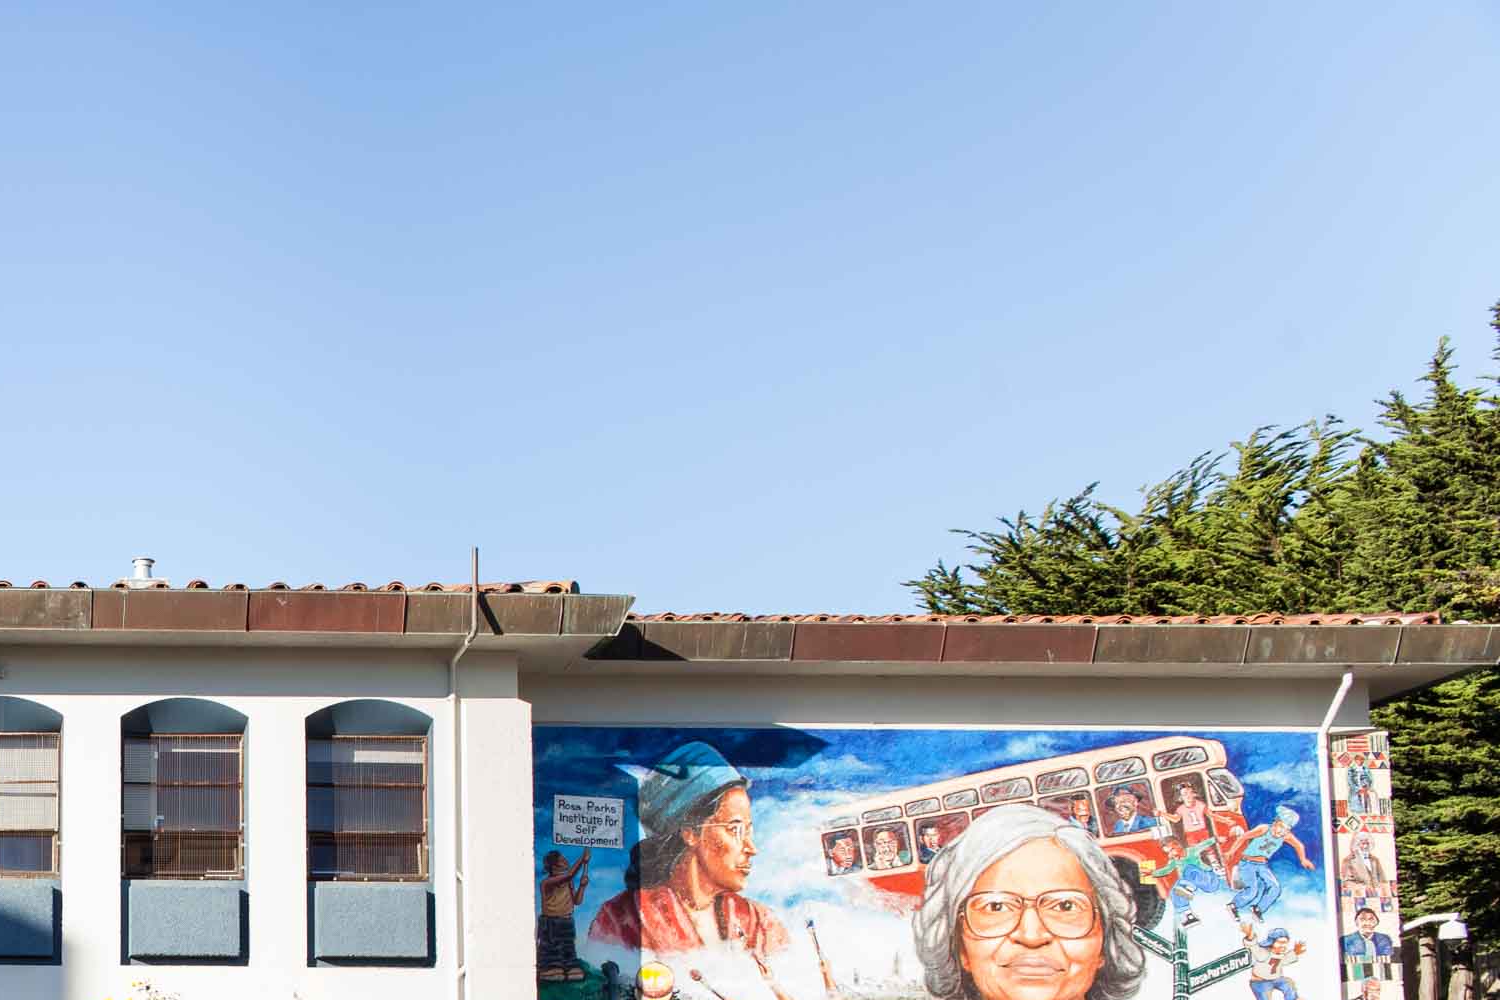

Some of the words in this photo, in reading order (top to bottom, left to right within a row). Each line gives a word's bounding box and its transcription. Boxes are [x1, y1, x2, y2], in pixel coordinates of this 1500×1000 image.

[558, 799, 582, 811] Rosa
[587, 801, 617, 814] Parks
[559, 812, 603, 826] Institute
[605, 815, 619, 827] for
[575, 824, 597, 835] Self
[555, 833, 619, 846] Development
[1268, 958, 1282, 975] 7
